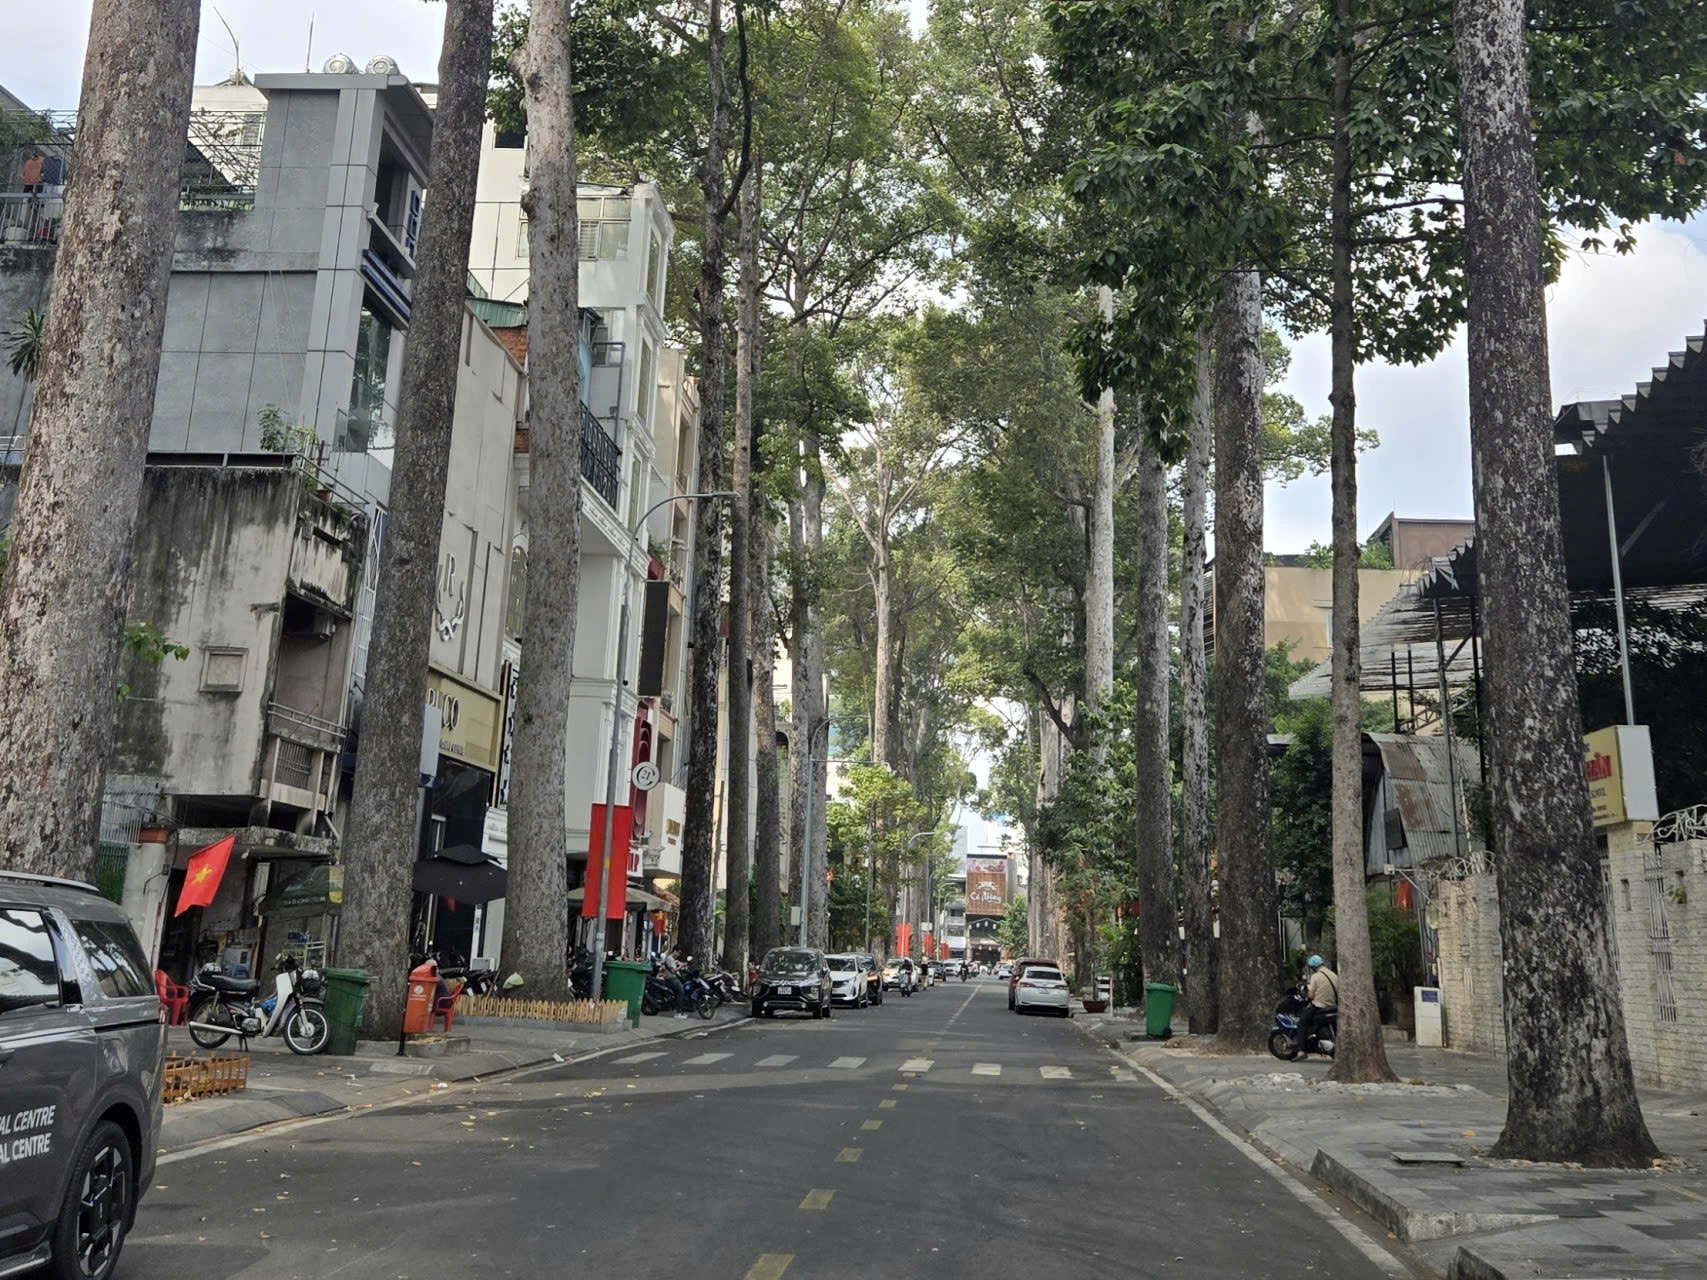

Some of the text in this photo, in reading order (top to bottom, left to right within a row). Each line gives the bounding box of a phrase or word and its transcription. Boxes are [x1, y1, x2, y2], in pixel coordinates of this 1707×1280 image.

[0, 1105, 57, 1135] AL CENTRE
[12, 1132, 52, 1161] CENTRE
